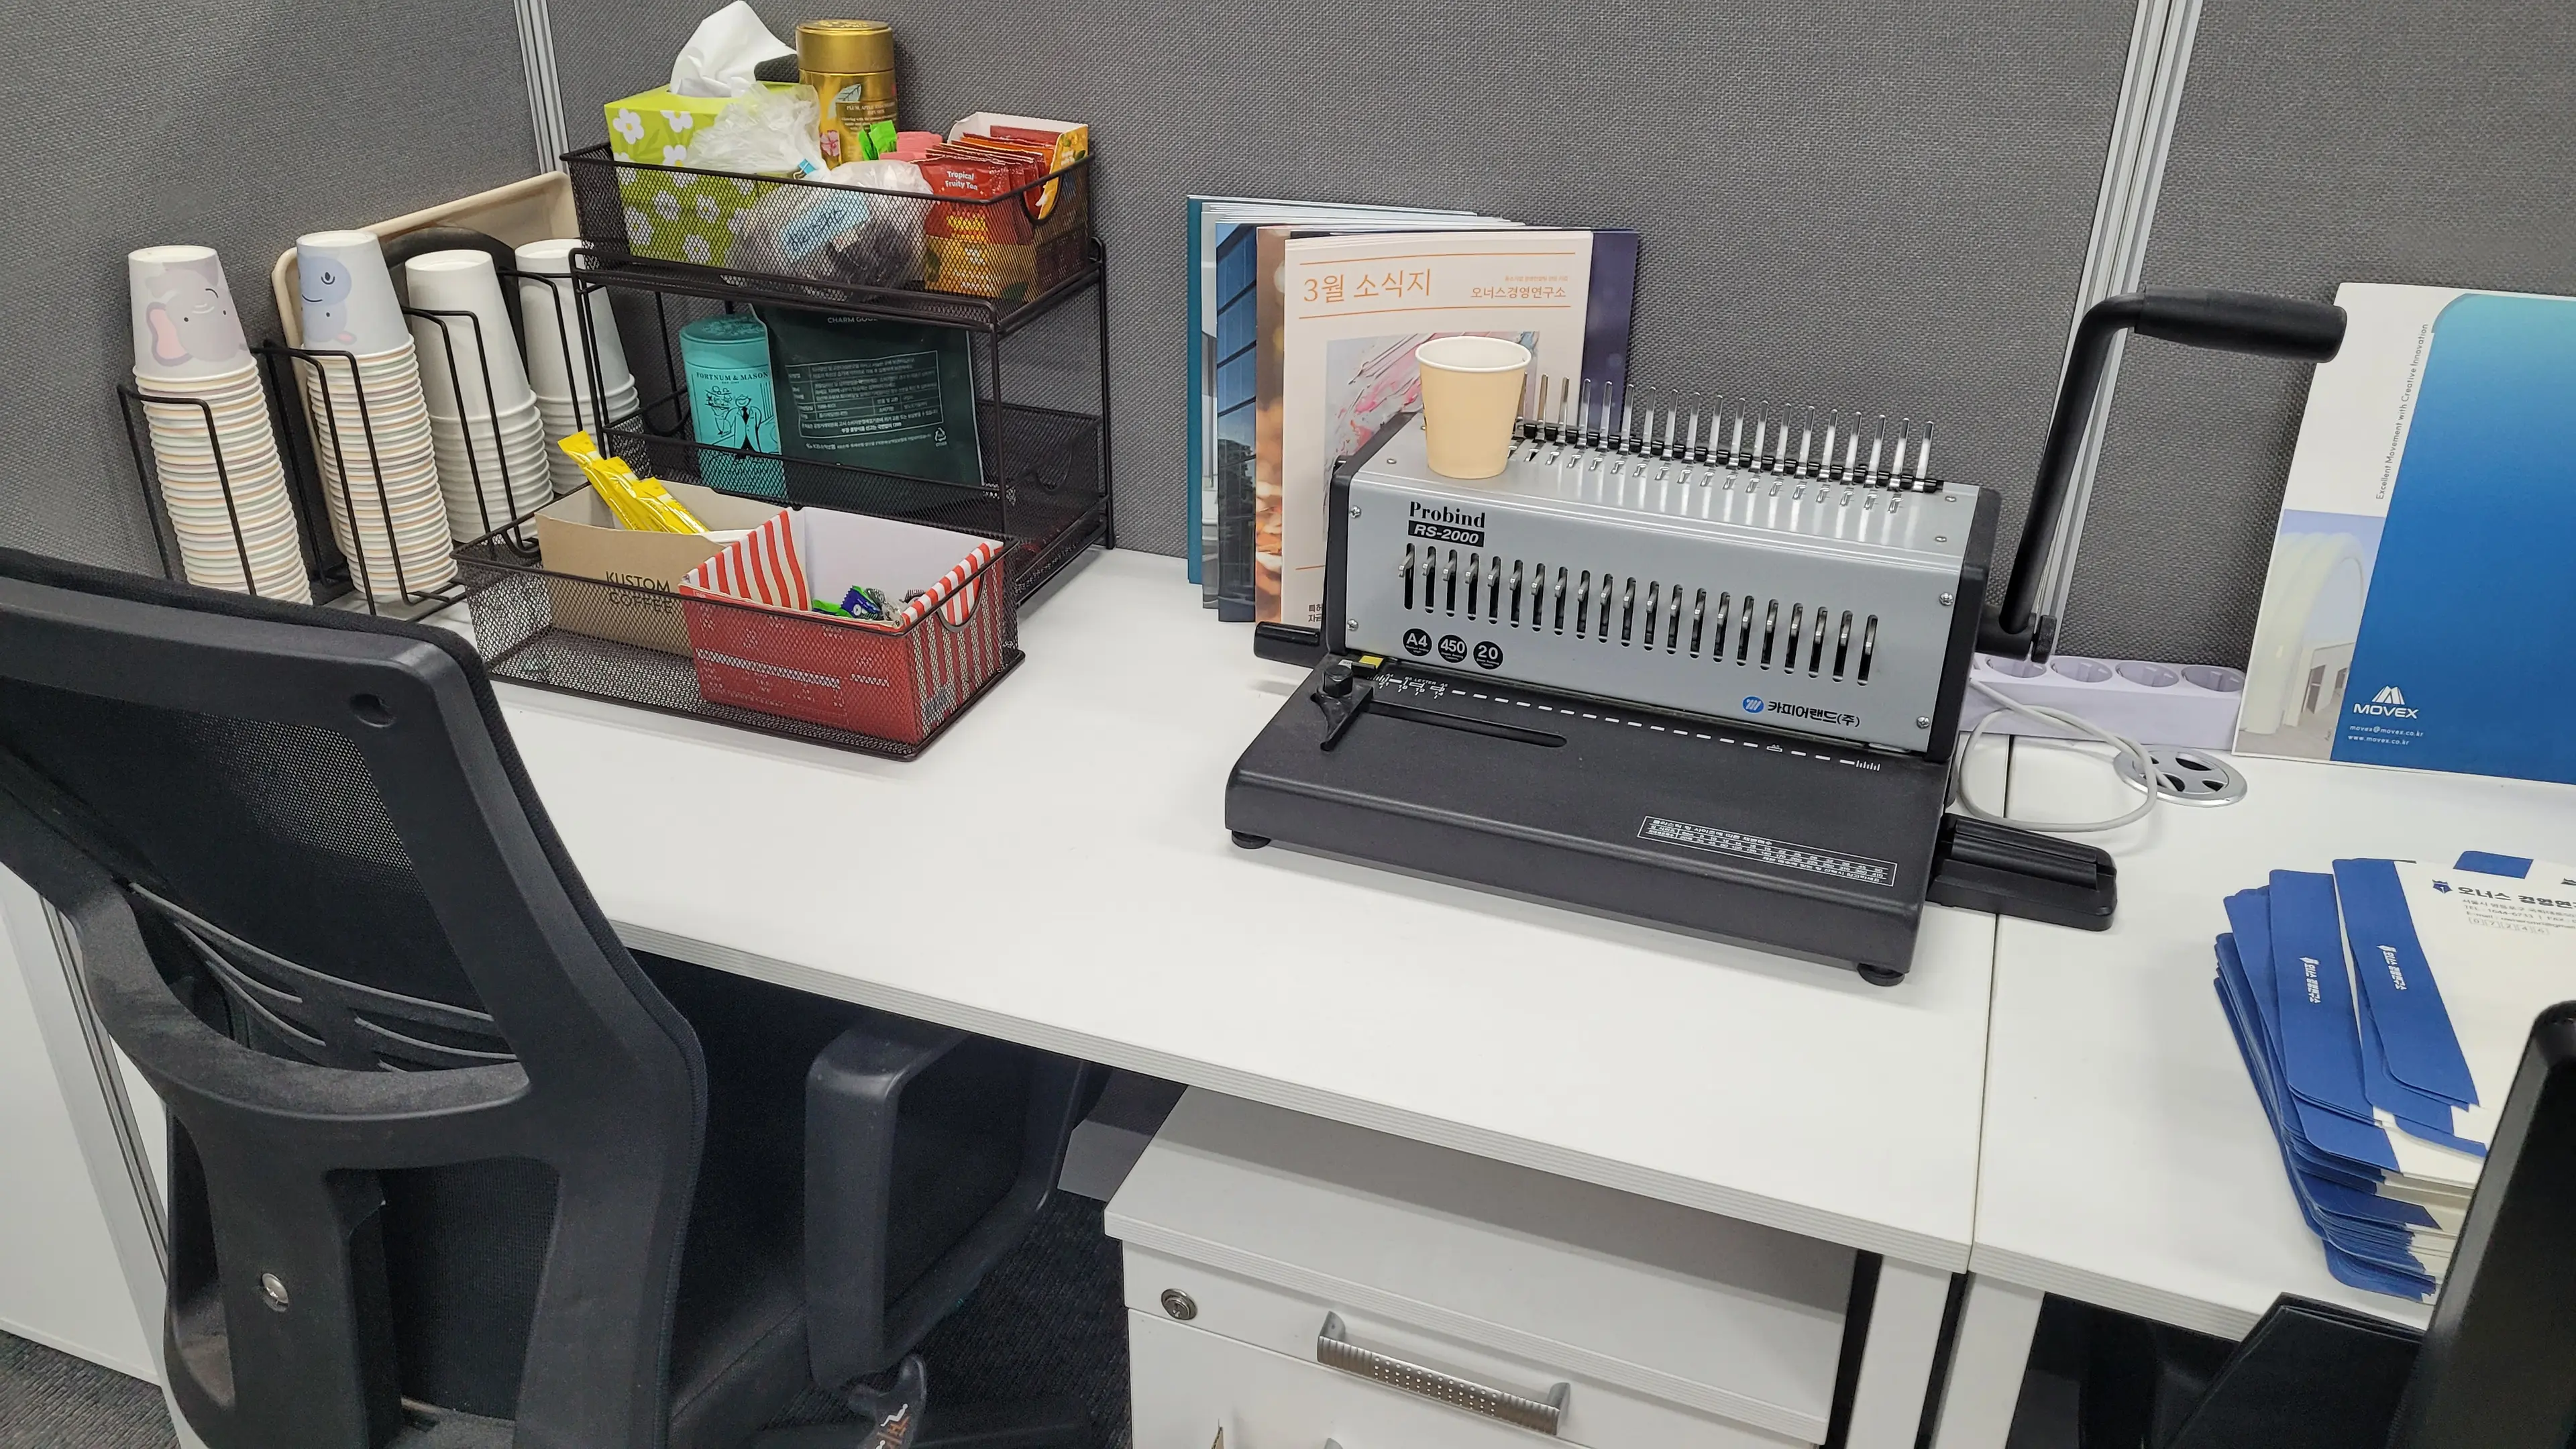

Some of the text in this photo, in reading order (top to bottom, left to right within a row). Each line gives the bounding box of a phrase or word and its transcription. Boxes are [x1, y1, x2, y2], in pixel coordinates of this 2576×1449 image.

[947, 170, 975, 180] Tropical
[945, 180, 965, 190] Fruity
[1303, 268, 1432, 303] 3월 소식지
[1470, 285, 1566, 299] 오너스경영연구소
[696, 372, 731, 381] FORTNUM
[740, 372, 769, 381] MASON
[2375, 323, 2428, 500] Excellent Movement with Creative Innovation
[1409, 500, 1486, 529] Probind
[1413, 524, 1481, 545] RS-2000
[605, 571, 670, 593] KUSTOM
[1406, 633, 1428, 647] A4
[1440, 638, 1466, 653] 450
[1477, 645, 1499, 660] 20
[1768, 700, 1860, 728] 카피어랜드(주)
[2353, 703, 2419, 719] MOVEX
[2349, 725, 2424, 737] movex@movex.co.kr
[2348, 735, 2410, 745] www.movex.co.kr
[2458, 886, 2512, 901] 오너스
